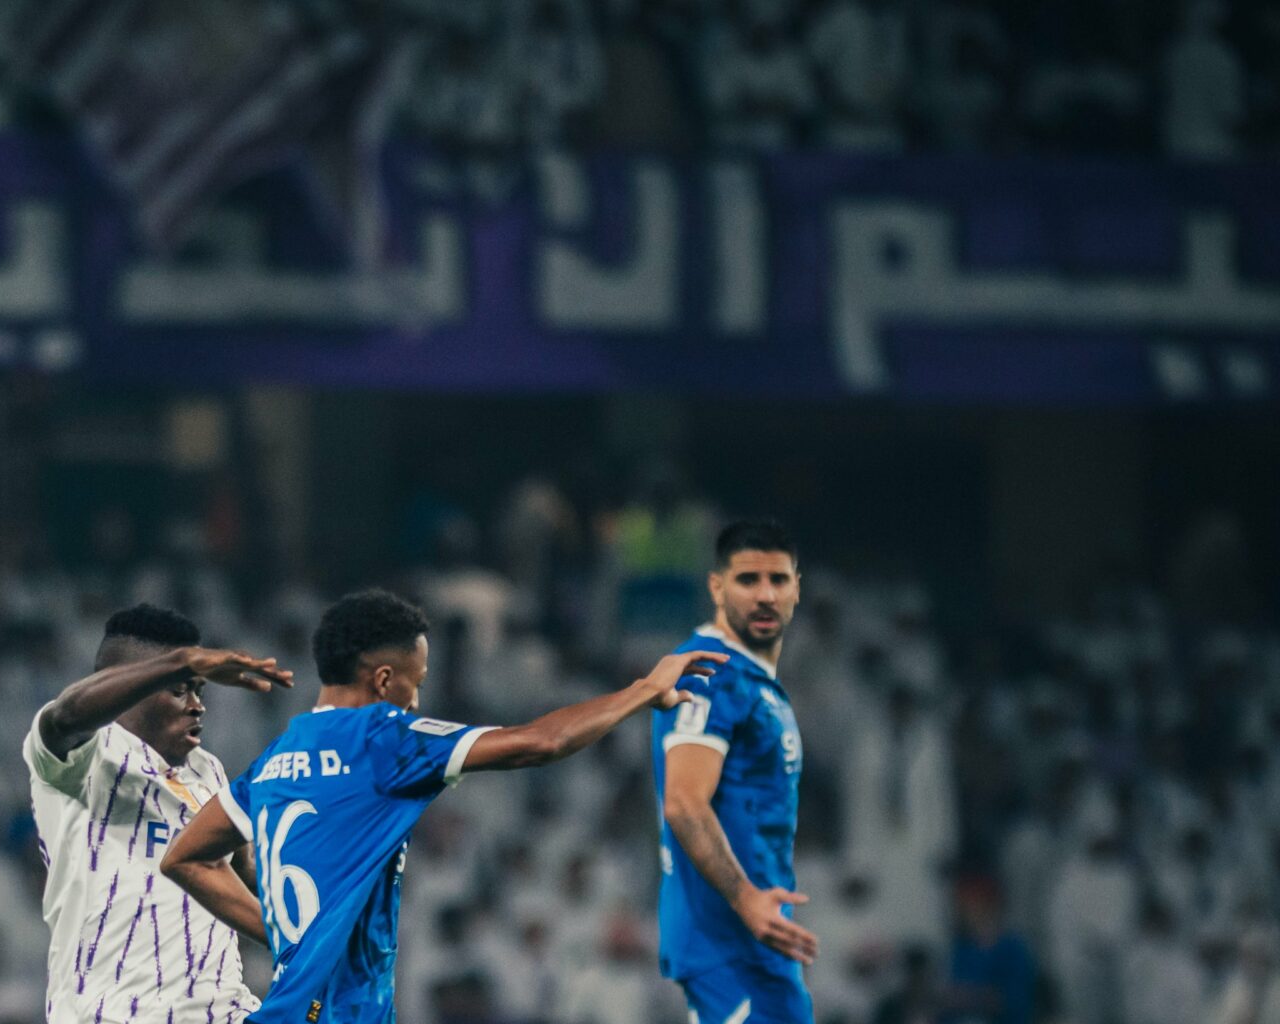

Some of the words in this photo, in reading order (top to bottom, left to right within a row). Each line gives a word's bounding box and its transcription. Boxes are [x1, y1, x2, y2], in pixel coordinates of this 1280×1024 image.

[251, 751, 312, 784] SSER
[319, 749, 351, 777] D.
[257, 800, 320, 956] 16
